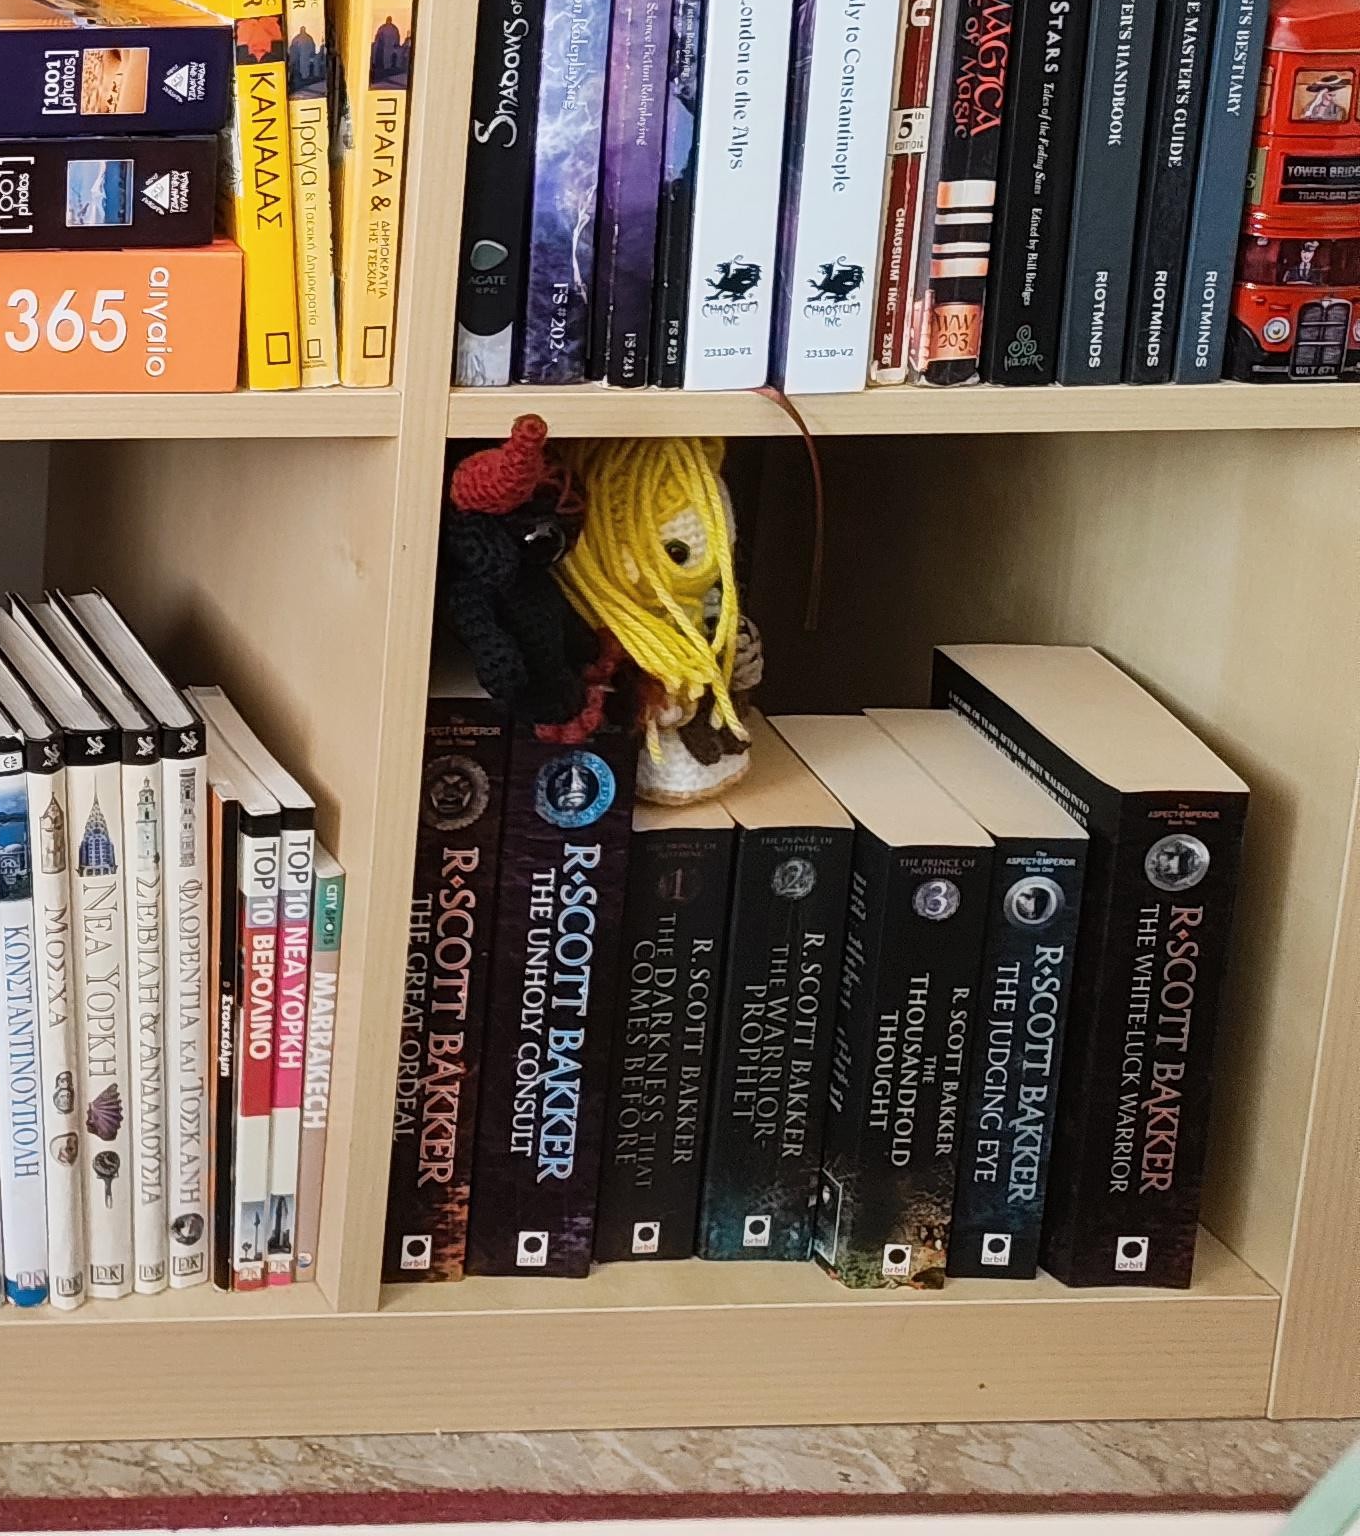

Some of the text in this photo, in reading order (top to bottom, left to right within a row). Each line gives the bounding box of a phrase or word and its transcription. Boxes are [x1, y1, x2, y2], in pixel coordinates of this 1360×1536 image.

[1044, 0, 1070, 74] STARS
[1227, 28, 1251, 117] BESTIARY
[249, 70, 283, 231] ΚΑΝΑΔΑΣ
[831, 48, 860, 193] Constantinople
[1108, 44, 1132, 147] HANDBOOK
[1168, 109, 1188, 168] GUIDE
[1287, 165, 1328, 177] TOWER
[4, 288, 127, 353] 365
[1088, 271, 1108, 368] RIOTMINDS
[1196, 271, 1218, 368] RIOTMINDS
[300, 971, 337, 1131] MARRAKECH
[511, 927, 550, 1157] UNHOLY CONSULT
[869, 1012, 899, 1130] THOUGHT
[891, 973, 929, 1166] THOUSANDFOLD
[418, 1031, 463, 1188] BAKKER
[537, 1027, 584, 1184] BAKKER
[673, 1065, 701, 1165] BAKKER
[781, 1059, 811, 1159] BAKKER
[935, 1082, 960, 1157] BAKKER
[974, 1018, 1013, 1183] JUDGING EYE
[1007, 1083, 1050, 1204] BAKKER
[1138, 1060, 1185, 1194] BAKKER
